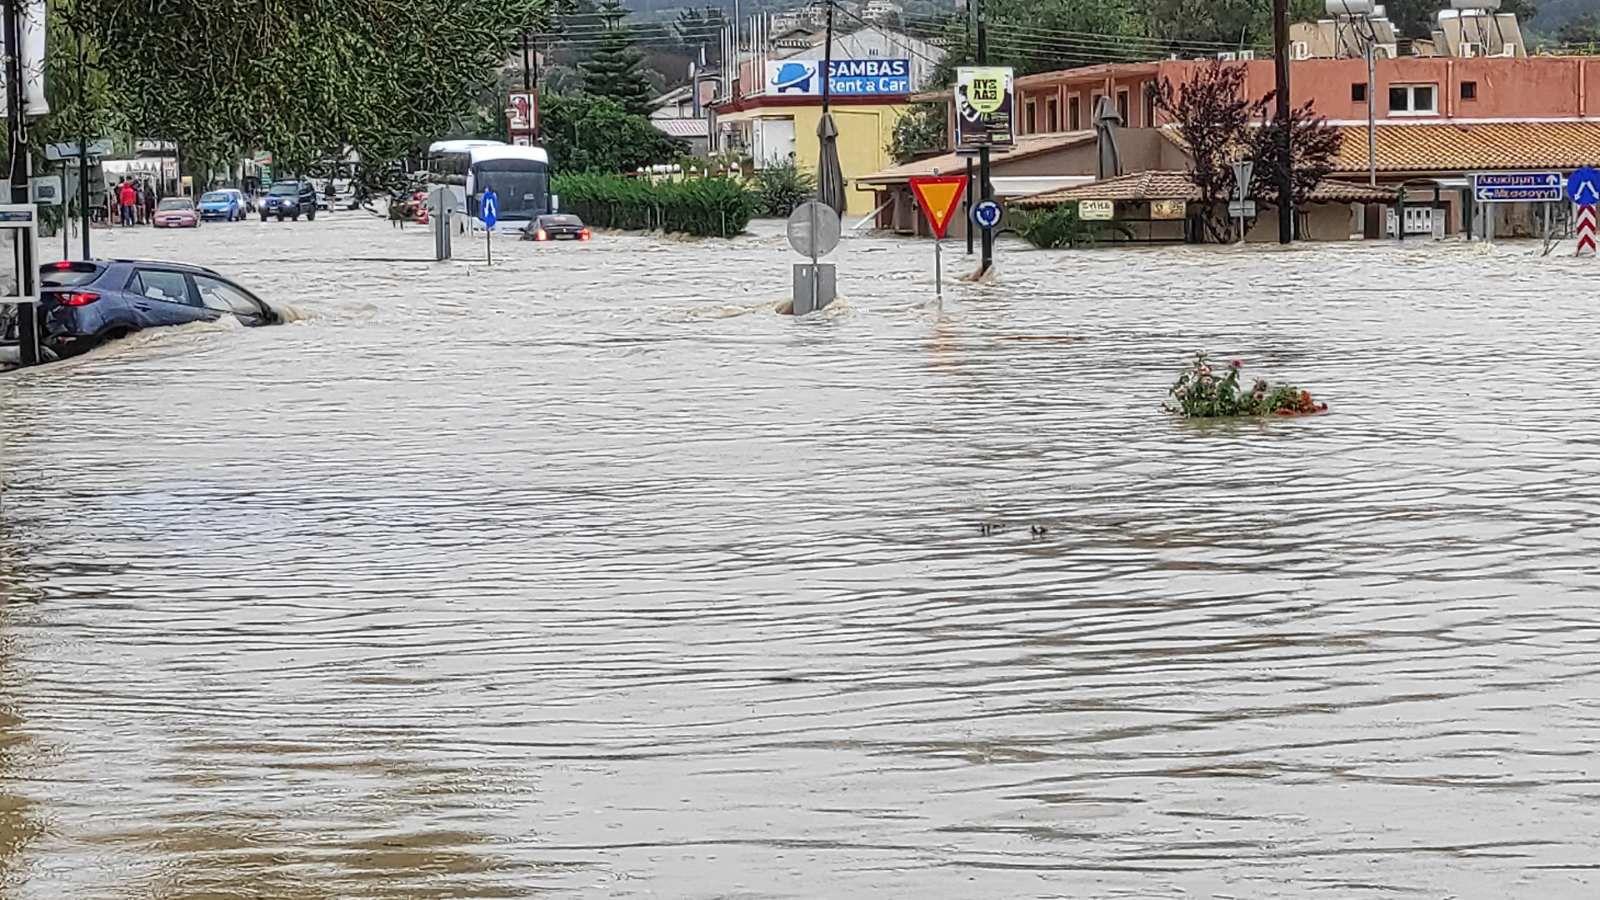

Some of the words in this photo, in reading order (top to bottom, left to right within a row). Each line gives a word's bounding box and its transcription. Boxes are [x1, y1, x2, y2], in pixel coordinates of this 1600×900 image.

[828, 61, 904, 76] SAMBAS
[828, 78, 863, 92] Rent
[866, 81, 875, 92] a
[879, 77, 906, 92] Car
